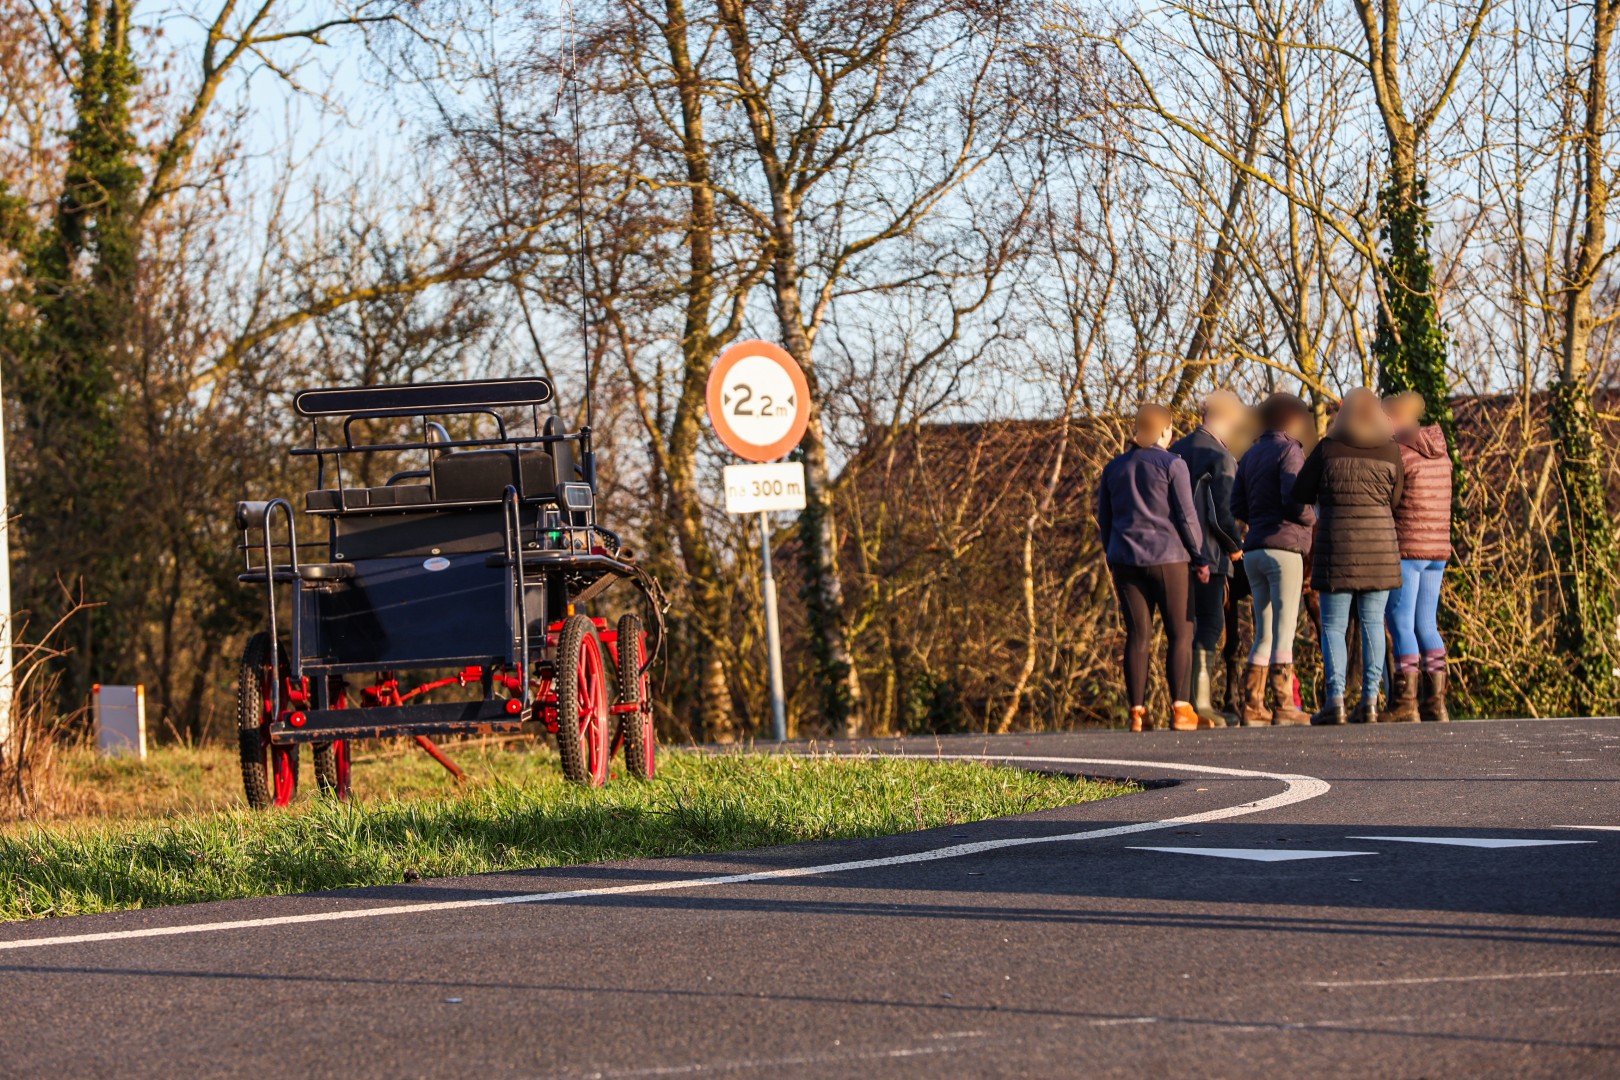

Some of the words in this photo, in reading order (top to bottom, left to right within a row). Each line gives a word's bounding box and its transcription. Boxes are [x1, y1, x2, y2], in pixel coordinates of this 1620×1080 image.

[728, 485, 747, 498] na
[751, 479, 783, 497] 300
[786, 481, 801, 496] m
